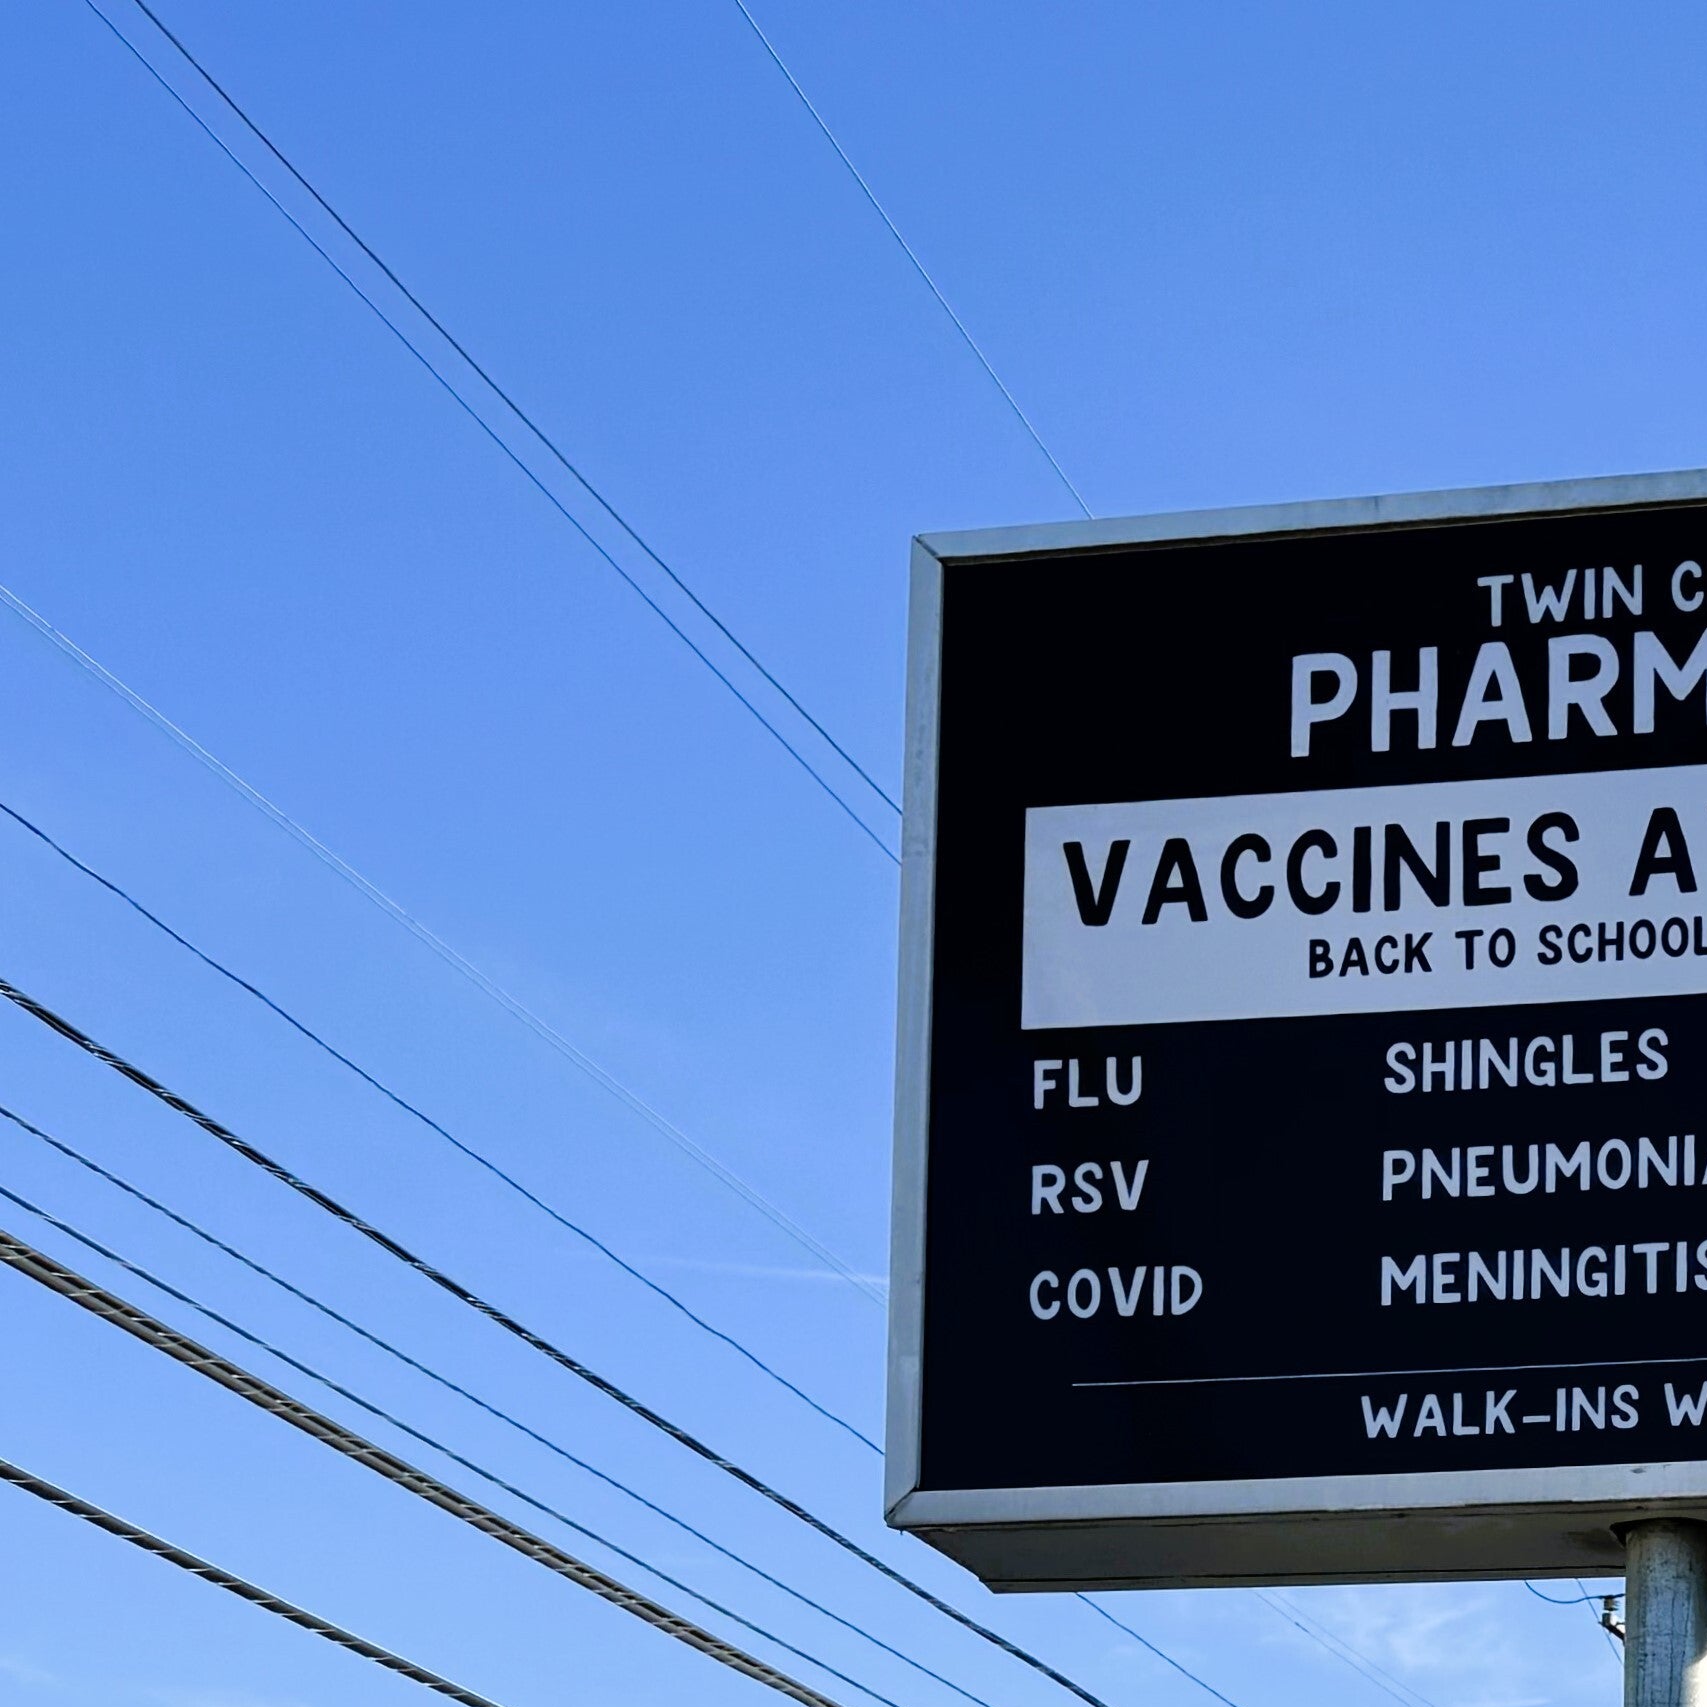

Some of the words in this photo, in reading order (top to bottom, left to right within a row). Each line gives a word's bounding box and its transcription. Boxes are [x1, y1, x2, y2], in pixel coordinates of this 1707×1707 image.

[1478, 565, 1642, 626] TWIN
[1063, 812, 1580, 927] VACCINES
[1309, 932, 1433, 978] BACK
[1455, 928, 1516, 970] TO
[1034, 1056, 1141, 1109] FLU
[1385, 1029, 1668, 1093] SHINGLES
[1032, 1160, 1148, 1214] RSV
[1030, 1266, 1202, 1319] COVID
[1362, 1385, 1638, 1438] WALK-INS
